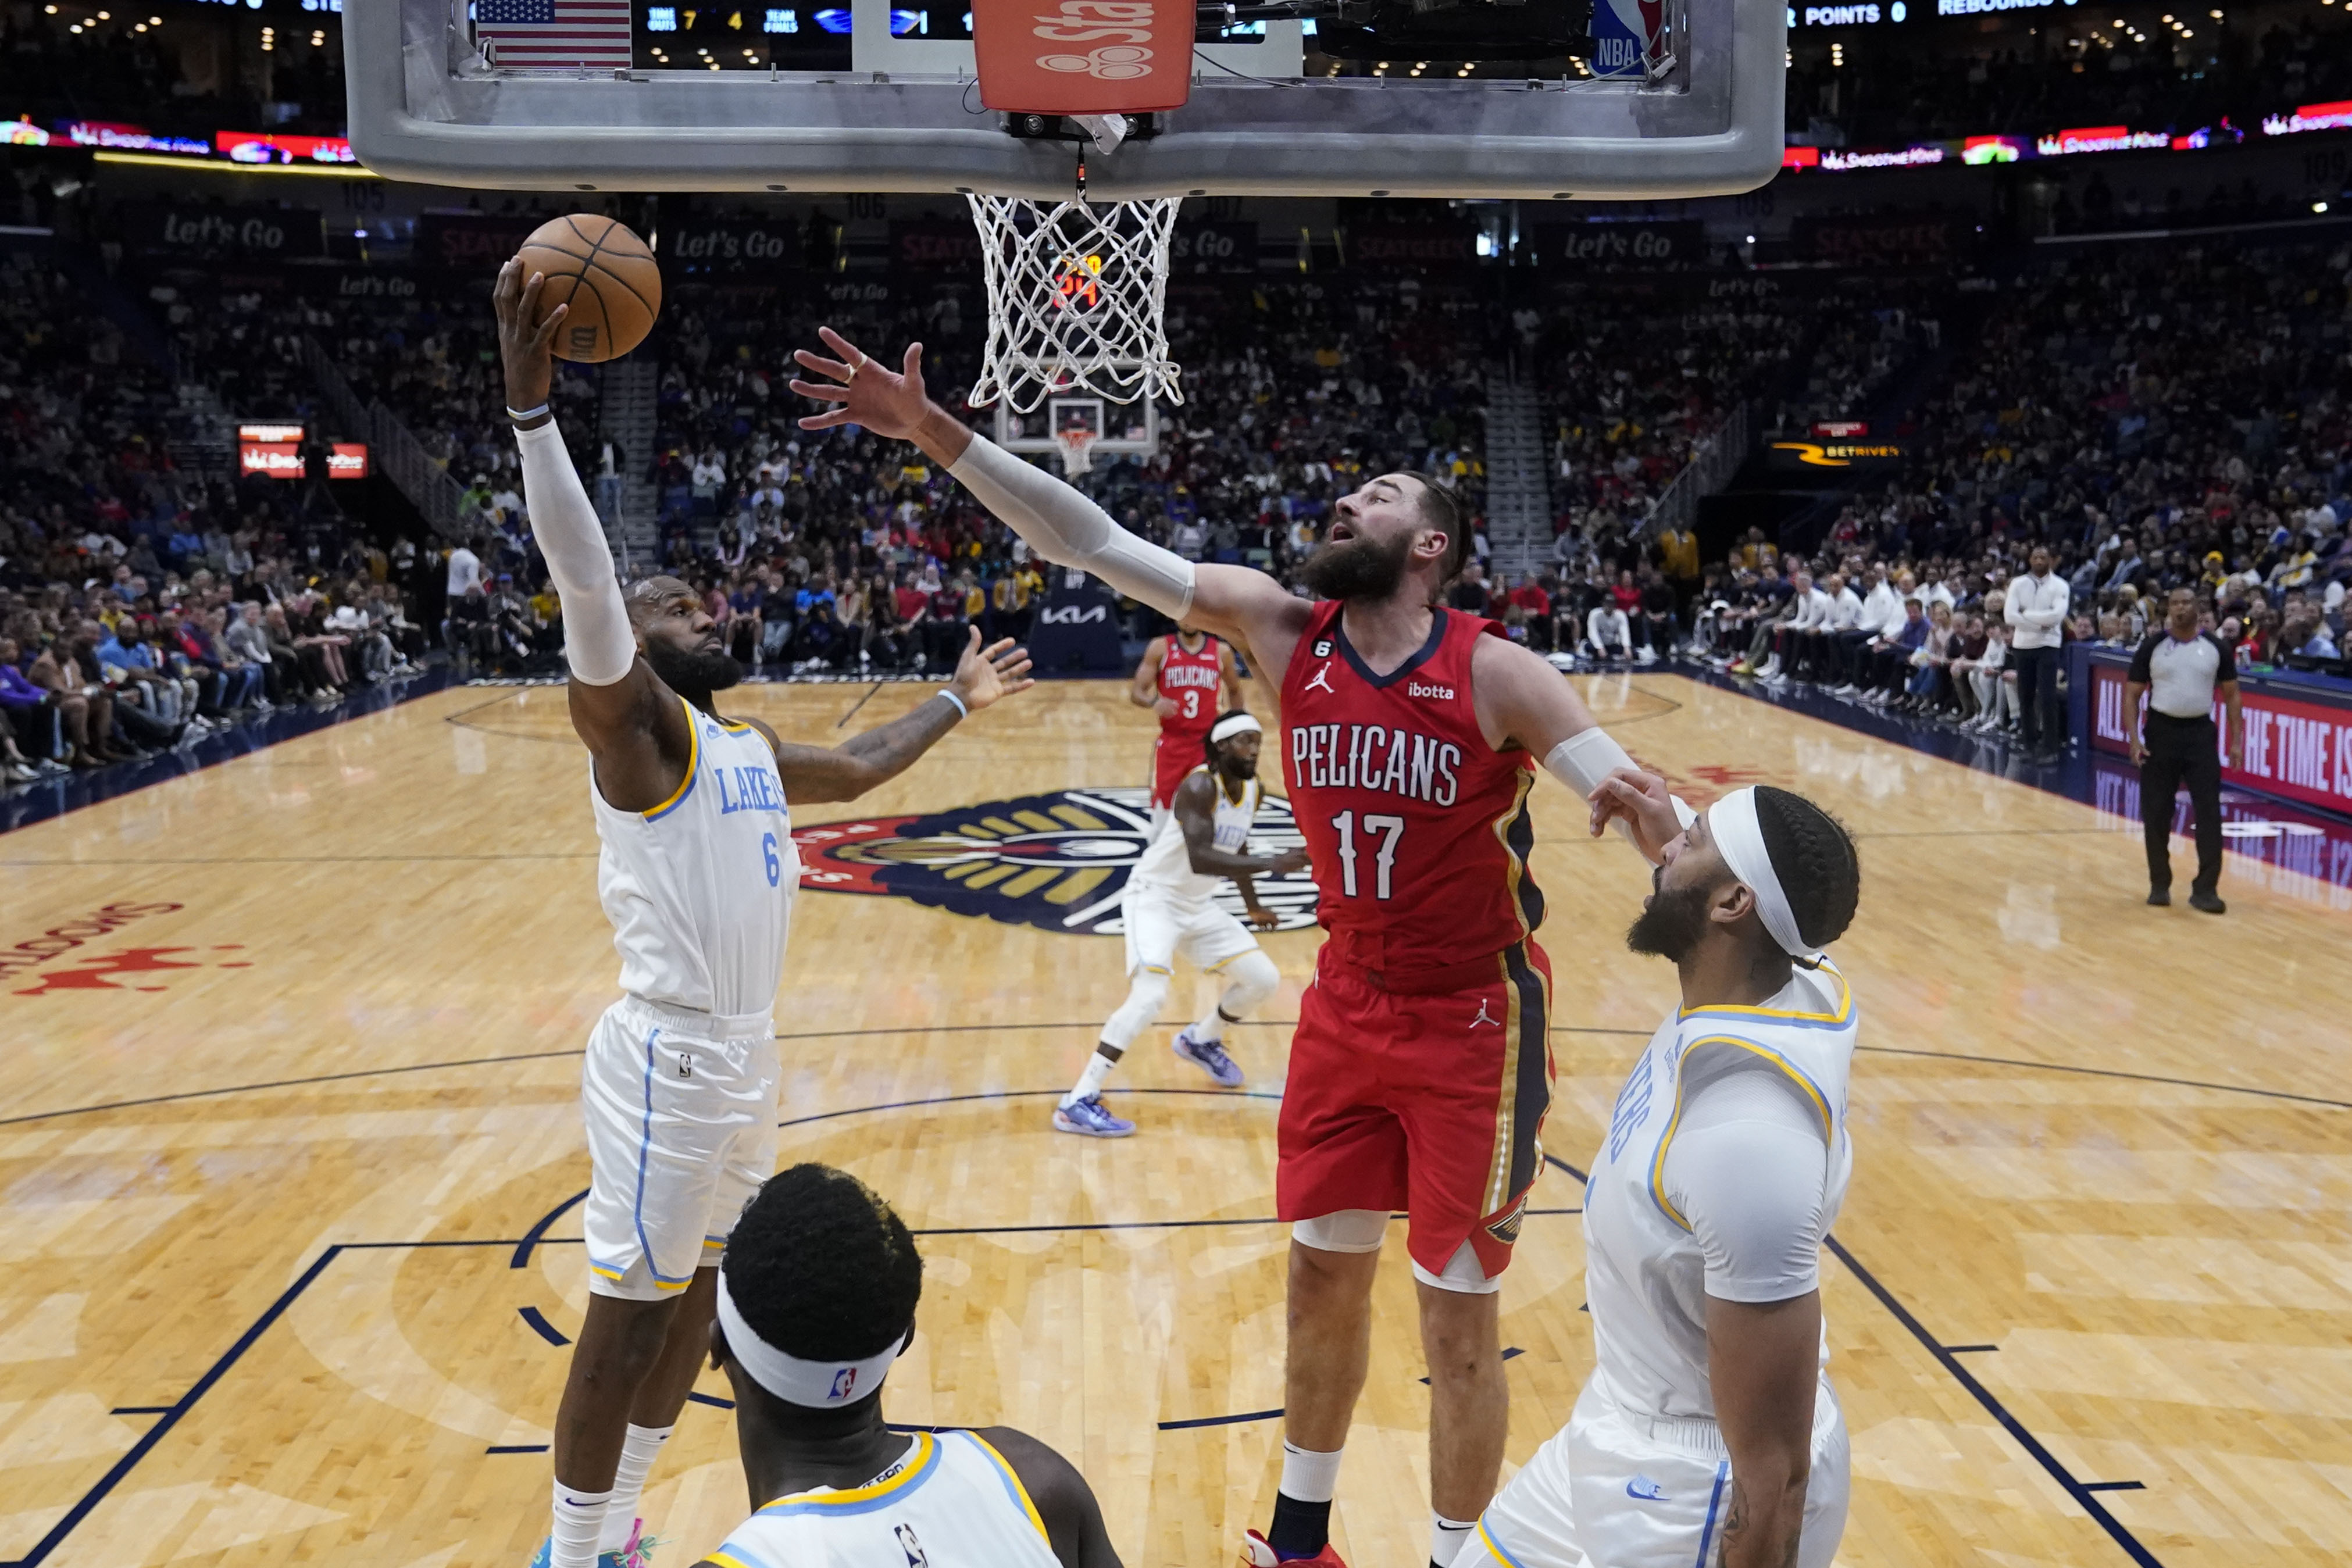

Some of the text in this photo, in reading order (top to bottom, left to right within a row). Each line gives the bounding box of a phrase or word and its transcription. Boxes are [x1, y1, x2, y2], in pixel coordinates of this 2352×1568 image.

[683, 10, 697, 30] 7
[727, 12, 743, 30] 4
[1805, 5, 1880, 25] POINTS
[1891, 1, 1907, 22] 0
[1598, 38, 1635, 66] NBA
[242, 218, 284, 248] Go
[674, 230, 785, 258] Let's Go
[1195, 230, 1234, 258] Go
[1633, 230, 1672, 258] Go
[389, 276, 416, 297] Go
[1041, 605, 1106, 624] KIA
[1314, 640, 1332, 658] 6
[1183, 690, 1199, 719] 3
[1409, 683, 1454, 700] ibotta
[2097, 679, 2123, 742] ALL
[1291, 723, 1461, 806] PELICANS
[2276, 713, 2330, 792] TIME
[715, 766, 787, 816] LAKES
[762, 833, 780, 887] 6
[1331, 810, 1404, 900] 17
